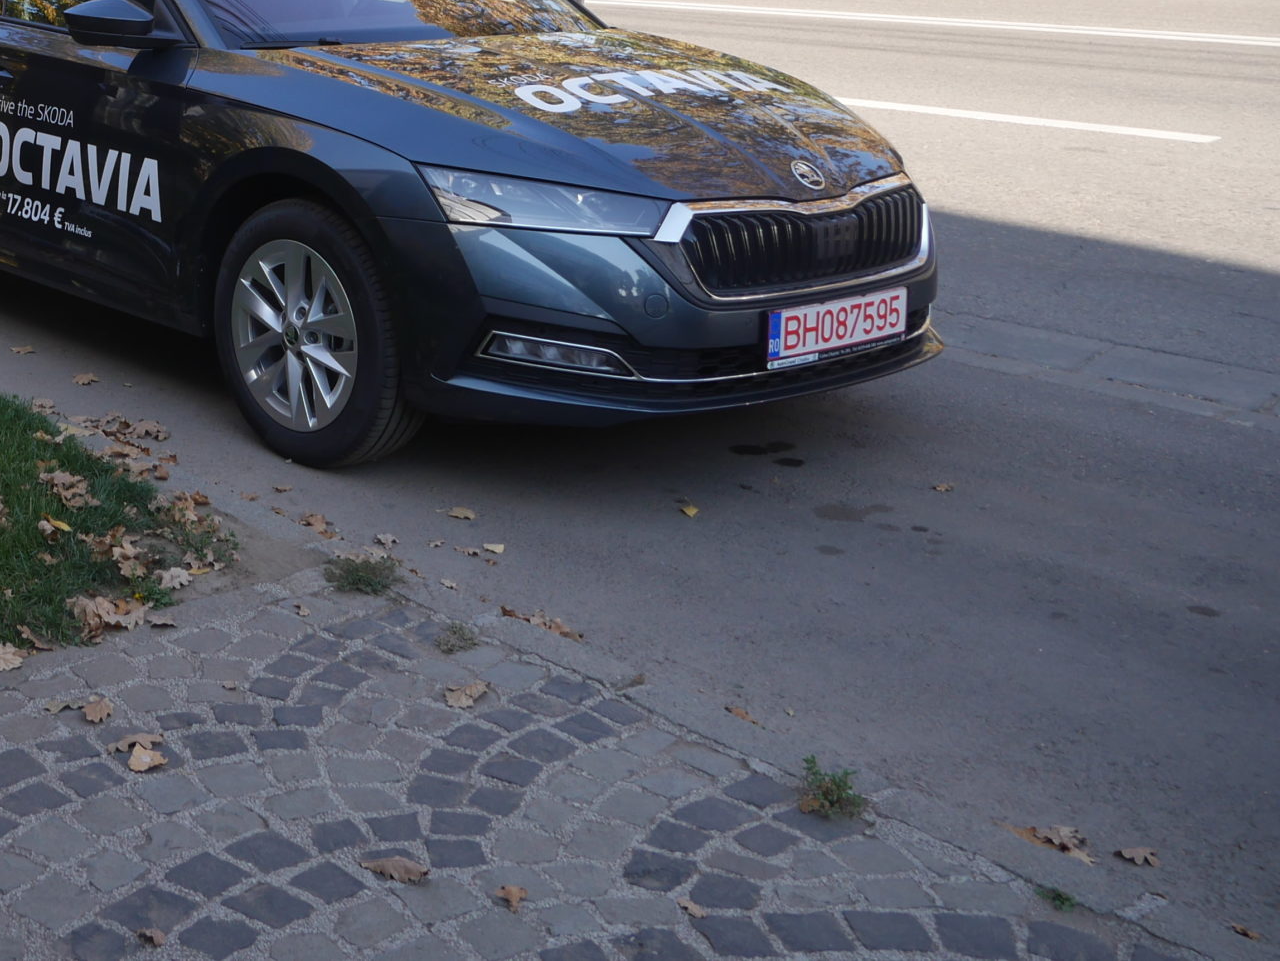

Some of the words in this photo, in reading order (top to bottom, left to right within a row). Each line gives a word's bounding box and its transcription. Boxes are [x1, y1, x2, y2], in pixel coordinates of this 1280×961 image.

[487, 71, 553, 88] SKODA
[514, 69, 795, 113] OCTAVIA
[17, 99, 35, 119] the
[36, 104, 74, 127] SKODA
[7, 193, 51, 225] 17.804
[54, 207, 65, 229] €
[64, 222, 75, 234] TVA
[75, 225, 92, 238] inclus
[783, 295, 900, 351] BH087595
[769, 339, 780, 353] RO
